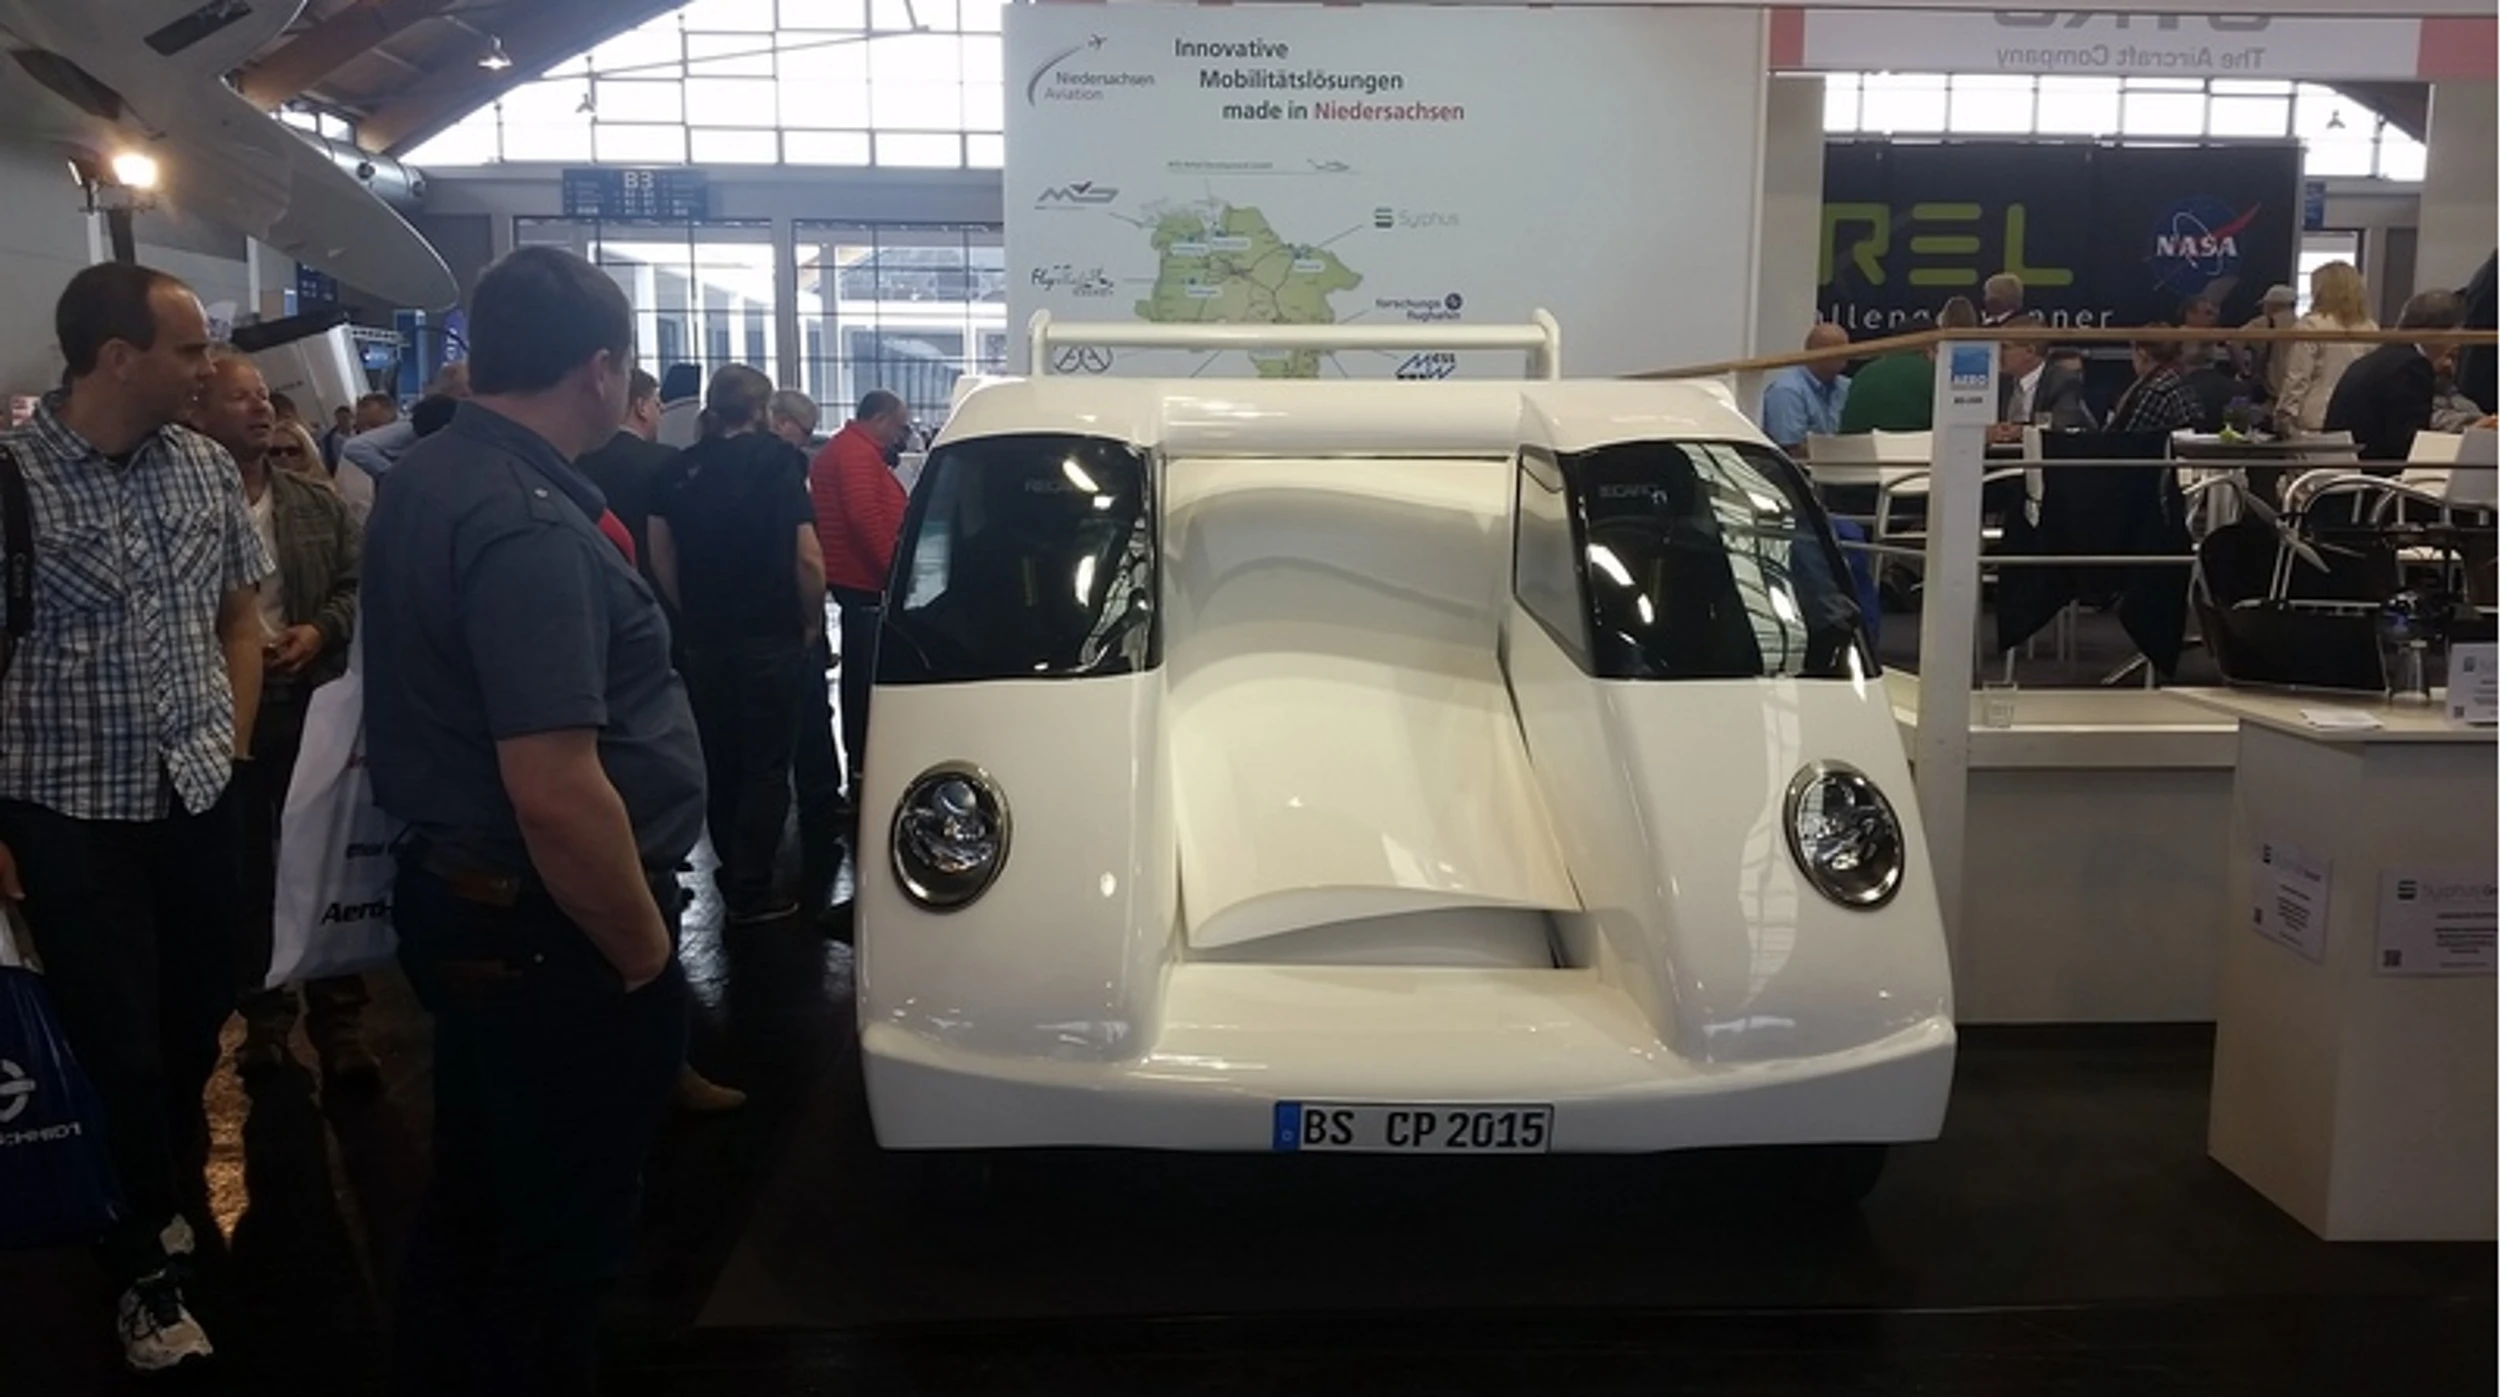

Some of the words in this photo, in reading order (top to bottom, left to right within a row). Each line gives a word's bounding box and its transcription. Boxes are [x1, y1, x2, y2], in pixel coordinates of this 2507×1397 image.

[1174, 38, 1289, 59] Innovative
[1056, 71, 1155, 86] Niedersachsen
[1200, 69, 1403, 94] Mobilitätslösungen
[1044, 87, 1103, 101] Aviation
[1222, 102, 1282, 121] made
[1287, 101, 1308, 121] in
[1314, 102, 1465, 121] Niedersachsen
[625, 171, 654, 189] B3
[2155, 235, 2238, 257] NASA
[1303, 1109, 1355, 1146] BS
[1386, 1111, 1437, 1147] CP
[1445, 1111, 1546, 1148] 2015
